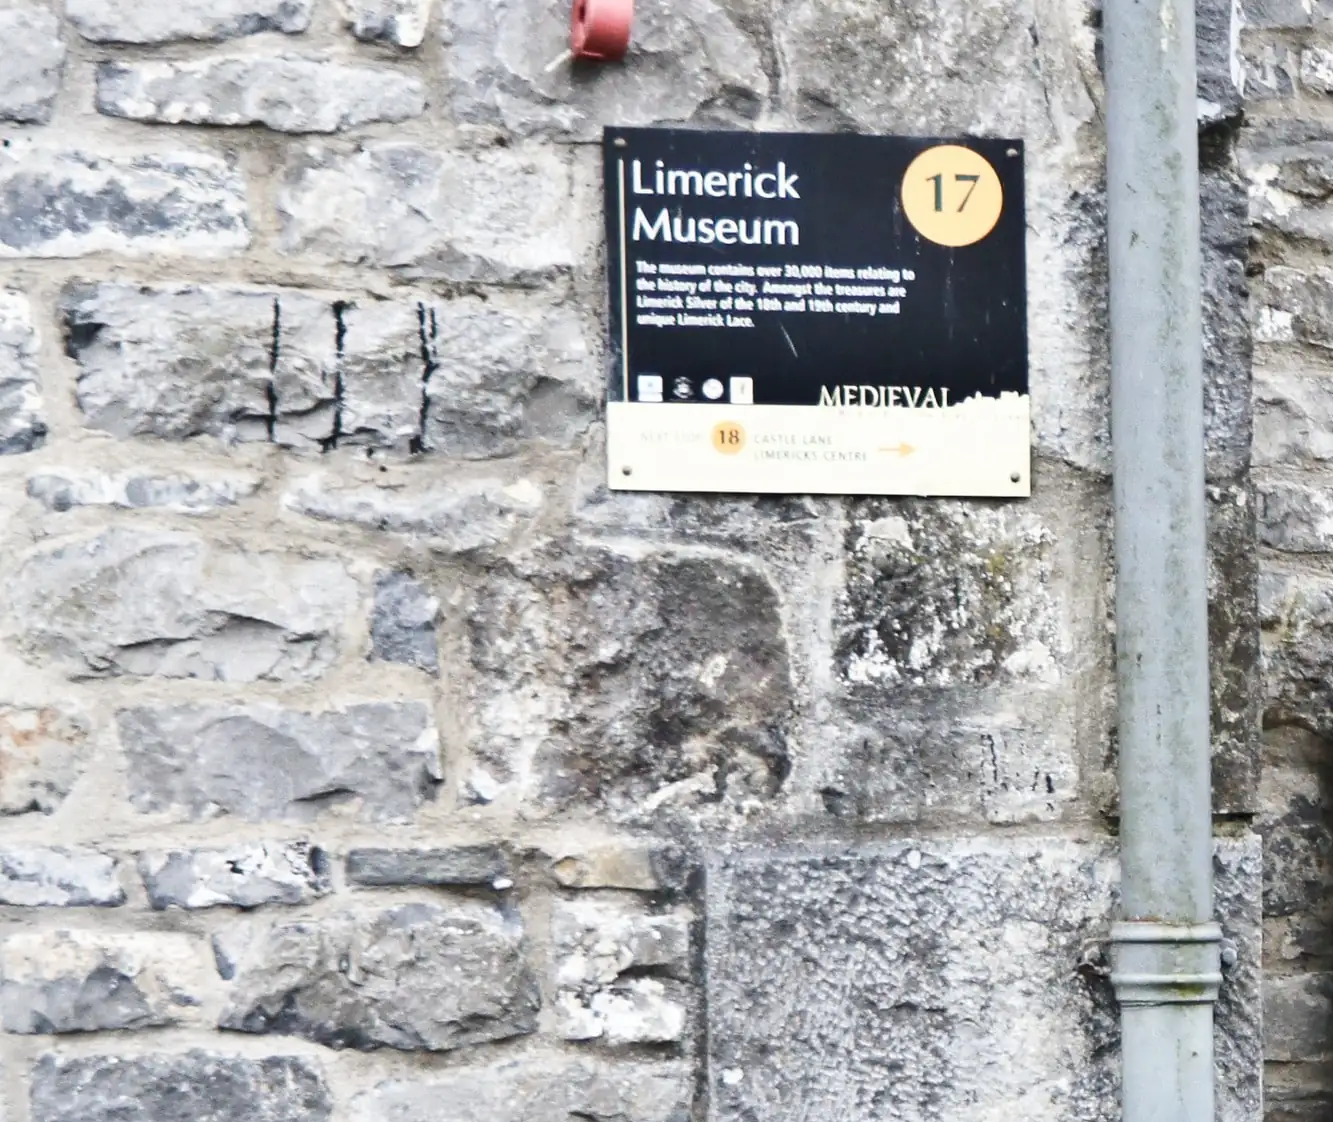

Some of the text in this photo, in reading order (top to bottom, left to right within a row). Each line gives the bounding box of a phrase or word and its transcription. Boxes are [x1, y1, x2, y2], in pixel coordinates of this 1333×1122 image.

[632, 159, 801, 199] Limerick
[925, 172, 981, 213] 17
[632, 207, 800, 245] Museum
[636, 260, 657, 274] The
[658, 264, 706, 275] museum
[707, 264, 755, 277] contains
[756, 266, 782, 277] over
[824, 265, 855, 279] items
[857, 266, 901, 284] relating
[902, 268, 916, 281] to
[636, 277, 656, 291] the
[657, 277, 697, 295] history
[698, 278, 711, 293] of
[713, 279, 733, 293] the
[763, 281, 813, 298] Amongst
[813, 281, 834, 296] the
[834, 283, 886, 297] treasures
[887, 286, 907, 298] are
[636, 294, 684, 309] Limerick
[685, 295, 718, 310] Silver
[719, 296, 733, 310] of
[734, 296, 754, 311] the
[783, 298, 806, 312] and
[834, 301, 877, 317] century
[878, 300, 901, 314] and
[636, 312, 676, 328] unique
[676, 312, 725, 327] Limerick
[719, 428, 740, 446] 18
